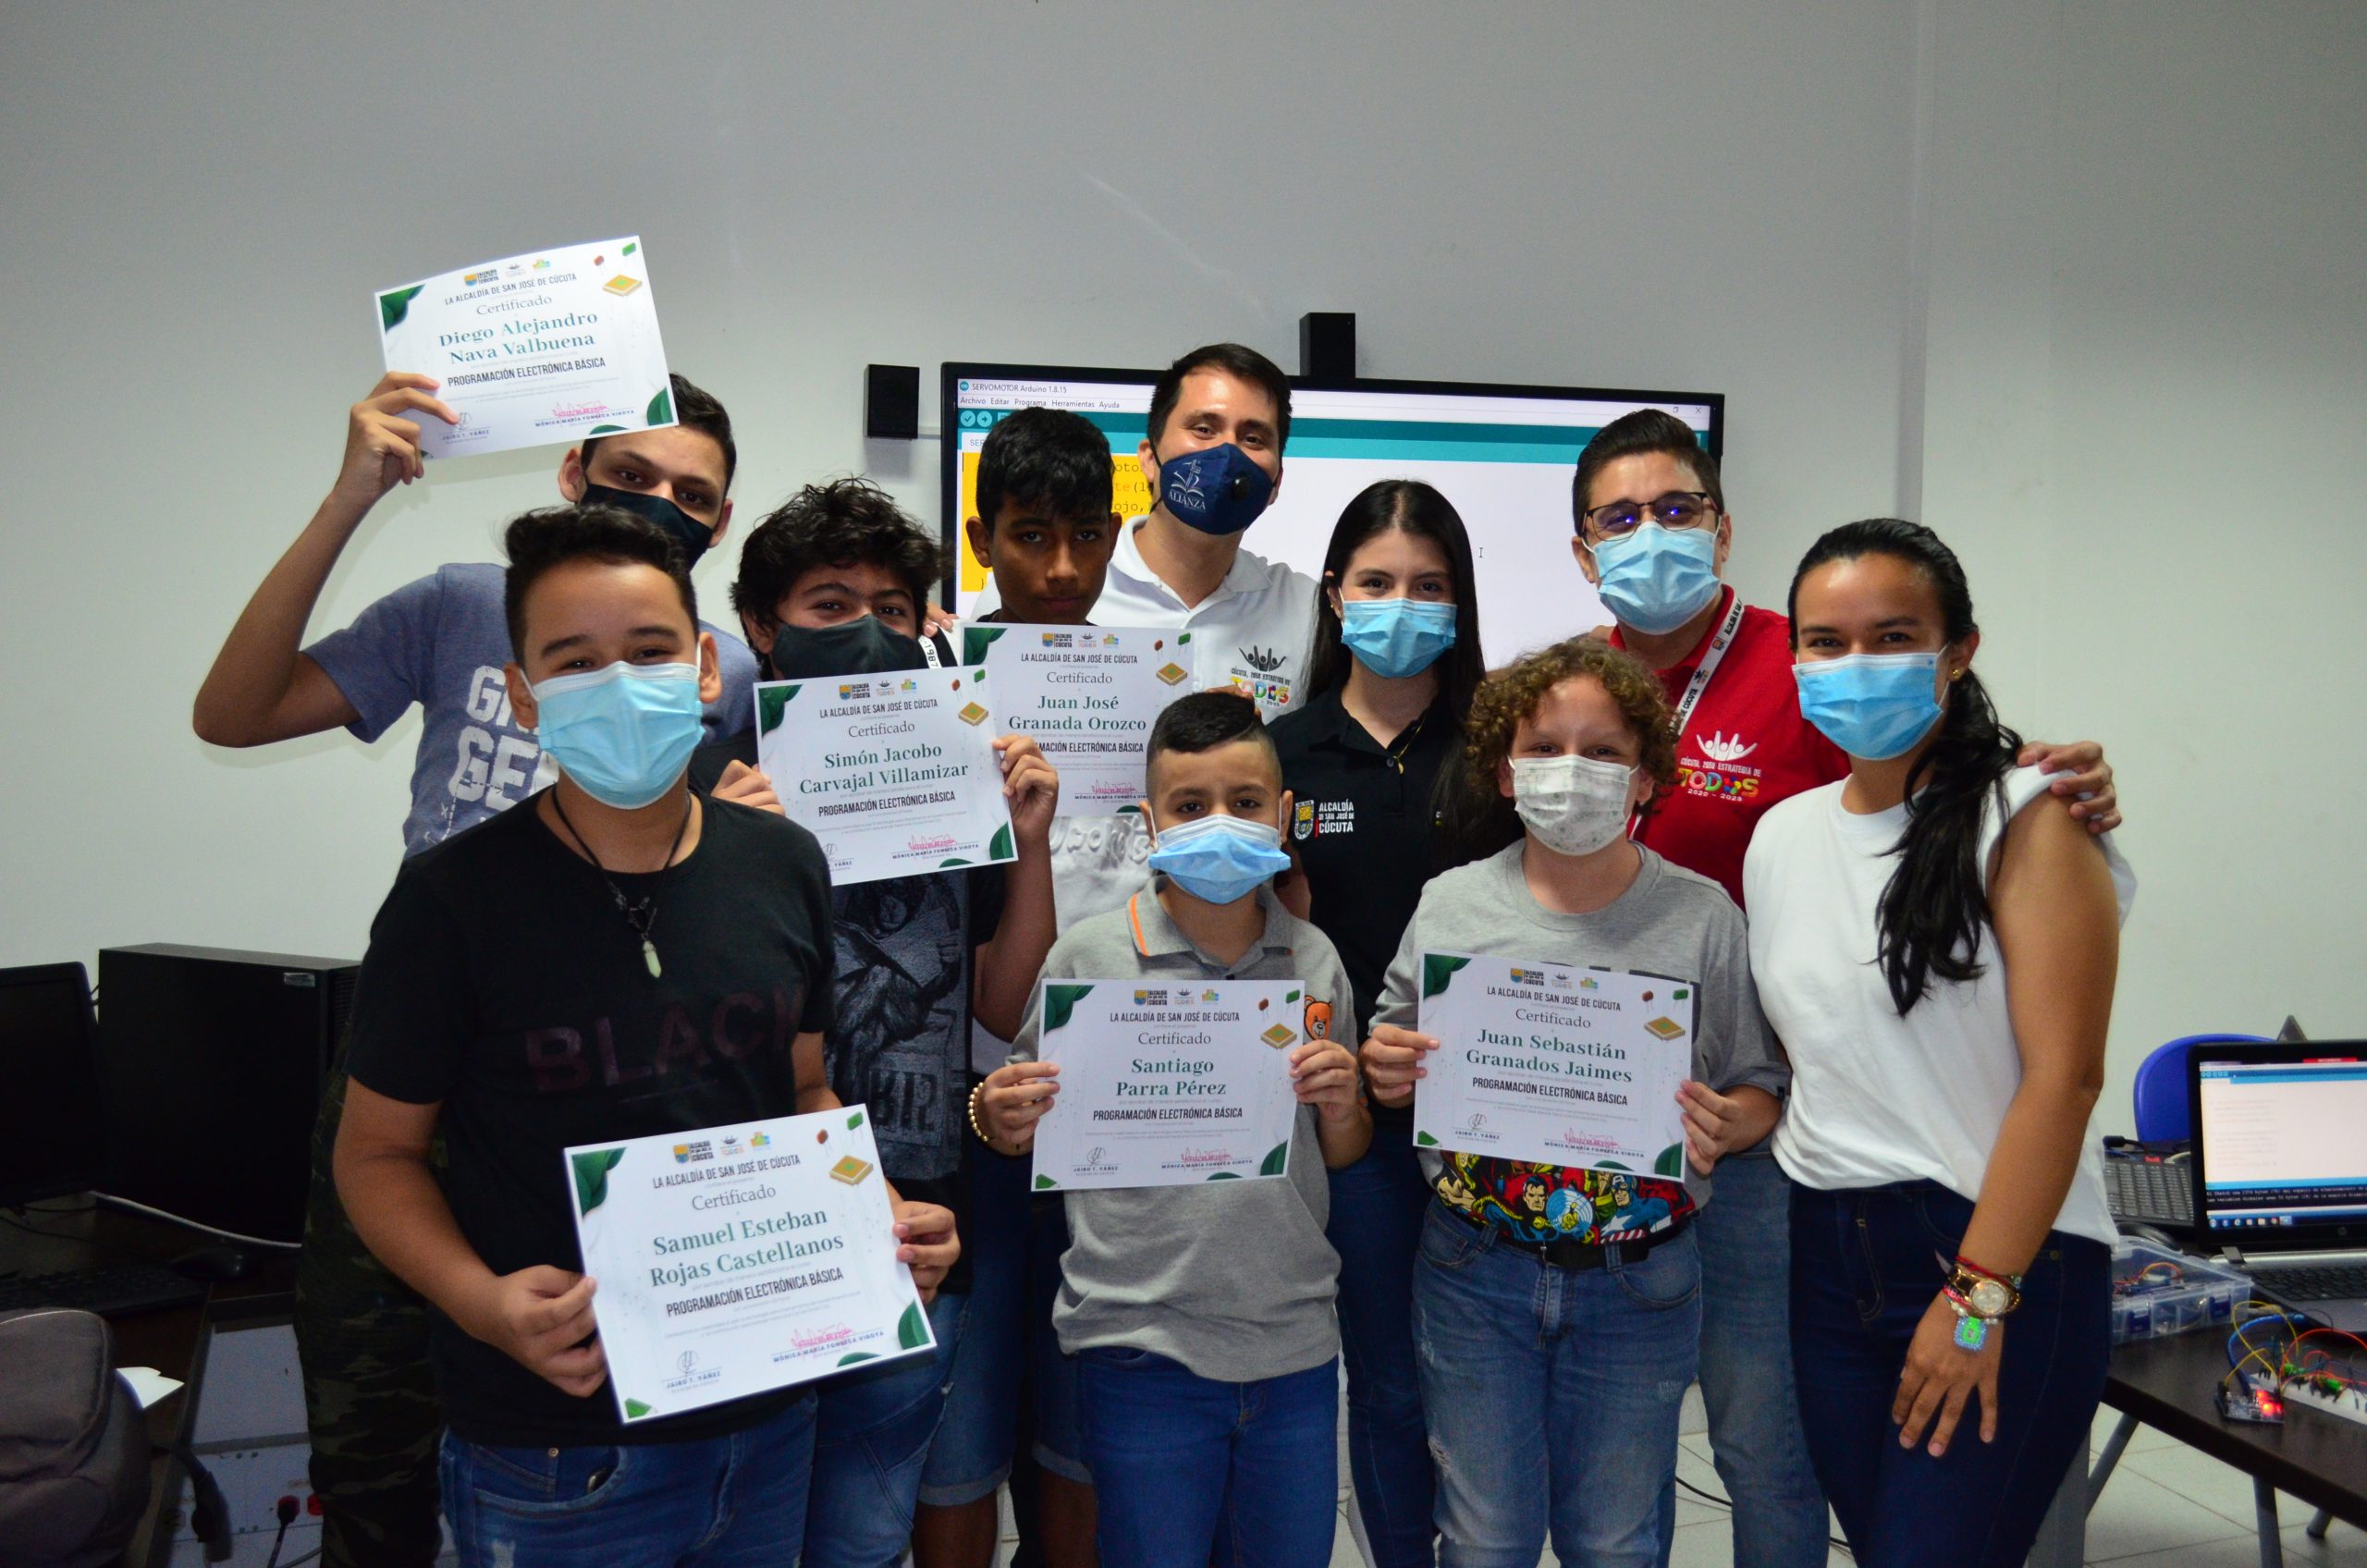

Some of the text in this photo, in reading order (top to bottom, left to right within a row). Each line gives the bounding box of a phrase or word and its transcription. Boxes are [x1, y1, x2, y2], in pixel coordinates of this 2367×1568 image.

[445, 297, 455, 306] LA
[455, 288, 490, 303] ALCALDÍA
[490, 286, 501, 295] DE
[501, 283, 517, 293] SAN
[519, 278, 536, 289] JOSÉ
[537, 277, 547, 287] DE
[548, 273, 577, 285] CÚCUTA
[476, 295, 553, 315] Certificado
[439, 312, 598, 347] Diego Alejandro
[450, 349, 497, 364] Nava
[503, 335, 595, 356] Valbuena
[448, 369, 516, 387] PROGRAMACIÓN
[516, 361, 574, 378] ELECTRÓNICA
[574, 357, 607, 371] BÁSICA
[972, 384, 1018, 392] SERVOMOTOR
[1014, 398, 1047, 407] Programa
[1051, 399, 1095, 408] Herramientas
[1111, 462, 1143, 472] oto
[1168, 491, 1206, 510] ALIANZA
[925, 644, 938, 667] 1987
[1021, 653, 1138, 664] LA ALCALDÍA DE SAN JOSÉ DE CÚCUTA
[1047, 671, 1113, 684] Certificado
[819, 709, 828, 719] LA
[829, 705, 862, 717] ALCALDÍA
[862, 704, 872, 715] DE
[872, 704, 886, 714] SAN
[887, 701, 902, 713] JOSÉ
[903, 701, 913, 711] DE
[914, 699, 938, 710] CÚCUTA
[1037, 695, 1119, 710] Juan José
[848, 720, 915, 738] Certificado
[1009, 716, 1147, 730] Granada Orozco
[825, 743, 942, 768] Simón Jacobo
[1069, 741, 1117, 753] ELECTRÓNICA
[1119, 741, 1144, 753] BÁSICA
[800, 771, 874, 794] Carvajal
[878, 764, 969, 785] Villamizar
[818, 799, 878, 817] PROGRAMACIÓN
[878, 793, 928, 810] ELECTRÓNICA
[928, 790, 956, 803] BÁSICA
[1318, 799, 1354, 813] ALCALDÍA
[1318, 820, 1354, 834] CÚCUTA
[1487, 986, 1496, 996] LA
[1497, 987, 1532, 1000] ALCALDÍA
[1534, 991, 1544, 1002] DE
[1545, 993, 1560, 1004] SAN
[1562, 996, 1579, 1006] JOSÉ
[1580, 998, 1591, 1008] DE
[1592, 999, 1621, 1011] CÚCUTA
[1110, 1011, 1240, 1023] LA ALCALDÍA DE SAN JOSÉ DE CÚCUTA
[1515, 1008, 1591, 1029] Certificado
[1137, 1032, 1211, 1045] Certificado
[1478, 1029, 1625, 1060] Juan Sebastián
[1132, 1058, 1214, 1077] Santiago
[1466, 1049, 1560, 1073] Granados
[1564, 1061, 1632, 1083] Jaimes
[1116, 1080, 1227, 1096] Parra Pérez
[1472, 1077, 1538, 1095] PROGRAMACIÓN
[1539, 1084, 1596, 1102] ELECTRÓNICA
[1597, 1091, 1628, 1106] BÁSICA
[1093, 1107, 1243, 1121] PROGRAMACIÓN ELECTRÓNICA BÁSICA
[653, 1177, 665, 1190] LA
[666, 1170, 705, 1187] ALCALDÍA
[705, 1168, 718, 1181] DE
[717, 1165, 736, 1179] SAN
[737, 1160, 756, 1175] JOSÉ
[756, 1159, 769, 1172] DE
[769, 1154, 802, 1170] CÚCUTA
[692, 1183, 777, 1211] Certificado
[653, 1210, 828, 1256] Samuel Esteban
[650, 1262, 711, 1288] Rojas
[717, 1235, 844, 1273] Castellanos
[666, 1289, 744, 1317] PROGRAMACIÓN
[744, 1275, 809, 1301] ELECTRÓNICA
[808, 1267, 844, 1286] BÁSICA
